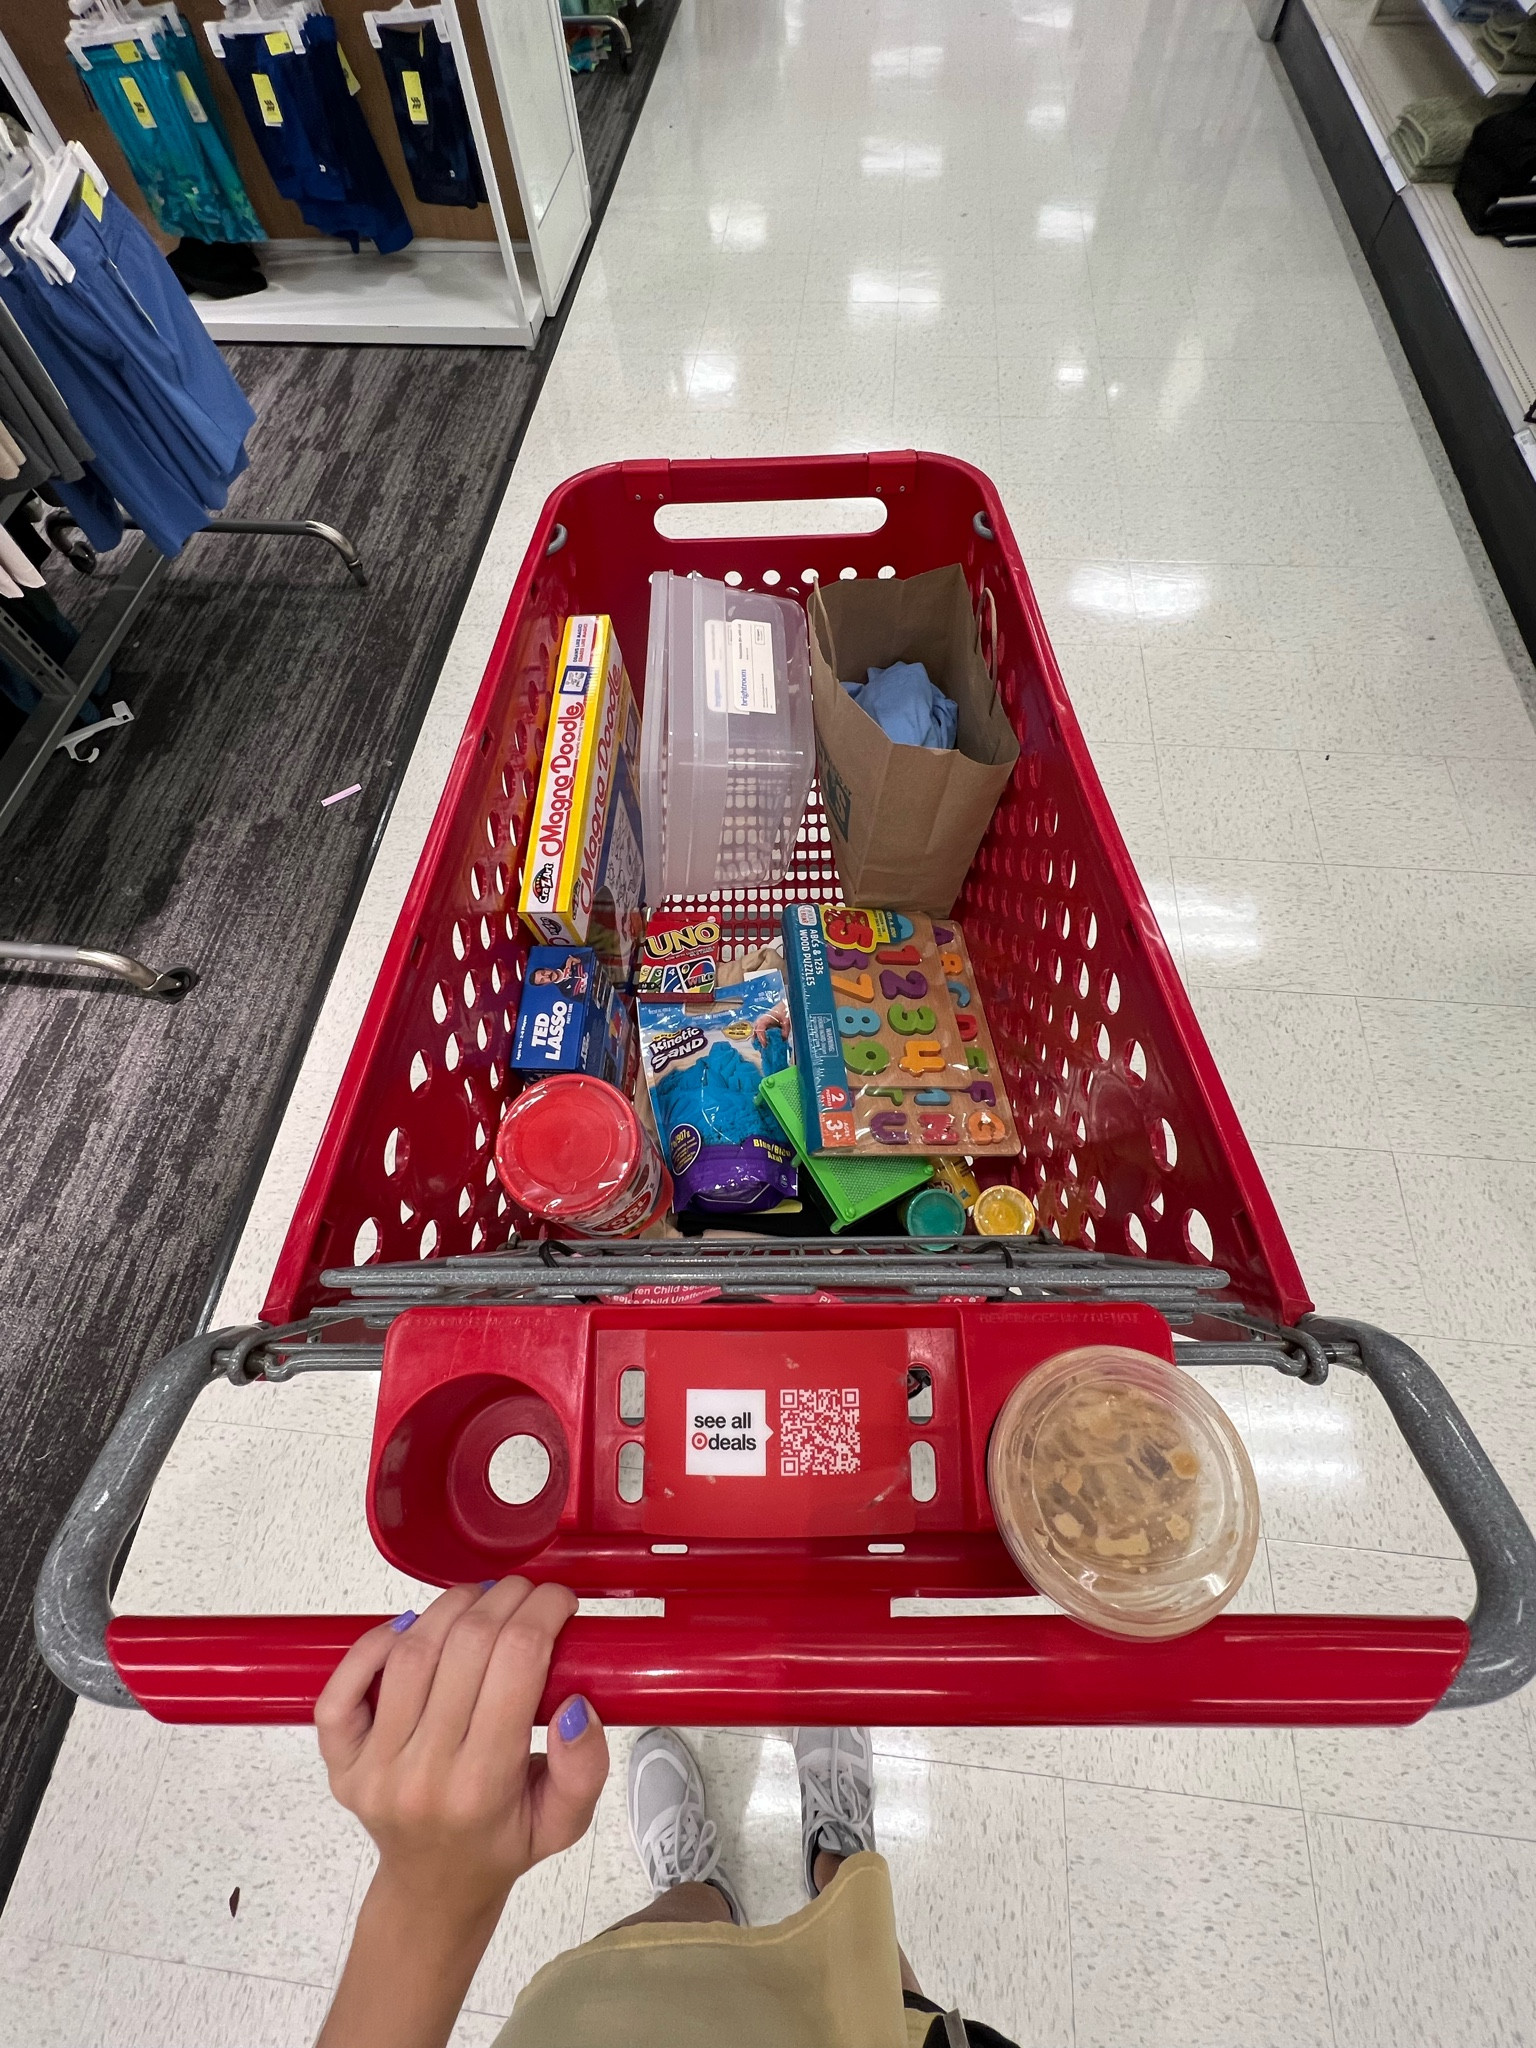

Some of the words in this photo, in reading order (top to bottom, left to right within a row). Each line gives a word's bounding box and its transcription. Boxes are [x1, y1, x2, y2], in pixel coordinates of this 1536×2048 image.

[741, 669, 749, 706] brightroom
[550, 702, 585, 774] Doodle
[645, 922, 720, 958] UNO
[799, 929, 810, 952] WOOD
[655, 969, 663, 977] 3
[669, 968, 676, 977] 4
[686, 972, 714, 987] WILD
[803, 952, 816, 986] PUZZLES
[531, 1013, 550, 1047] TED
[545, 1001, 567, 1061] LASSO
[650, 1027, 700, 1054] Kinetic
[831, 1093, 844, 1102] 2
[826, 1120, 843, 1141] 3+
[653, 1286, 680, 1295] Child
[694, 1415, 726, 1429] see
[731, 1412, 751, 1429] all
[708, 1434, 757, 1451] deals
